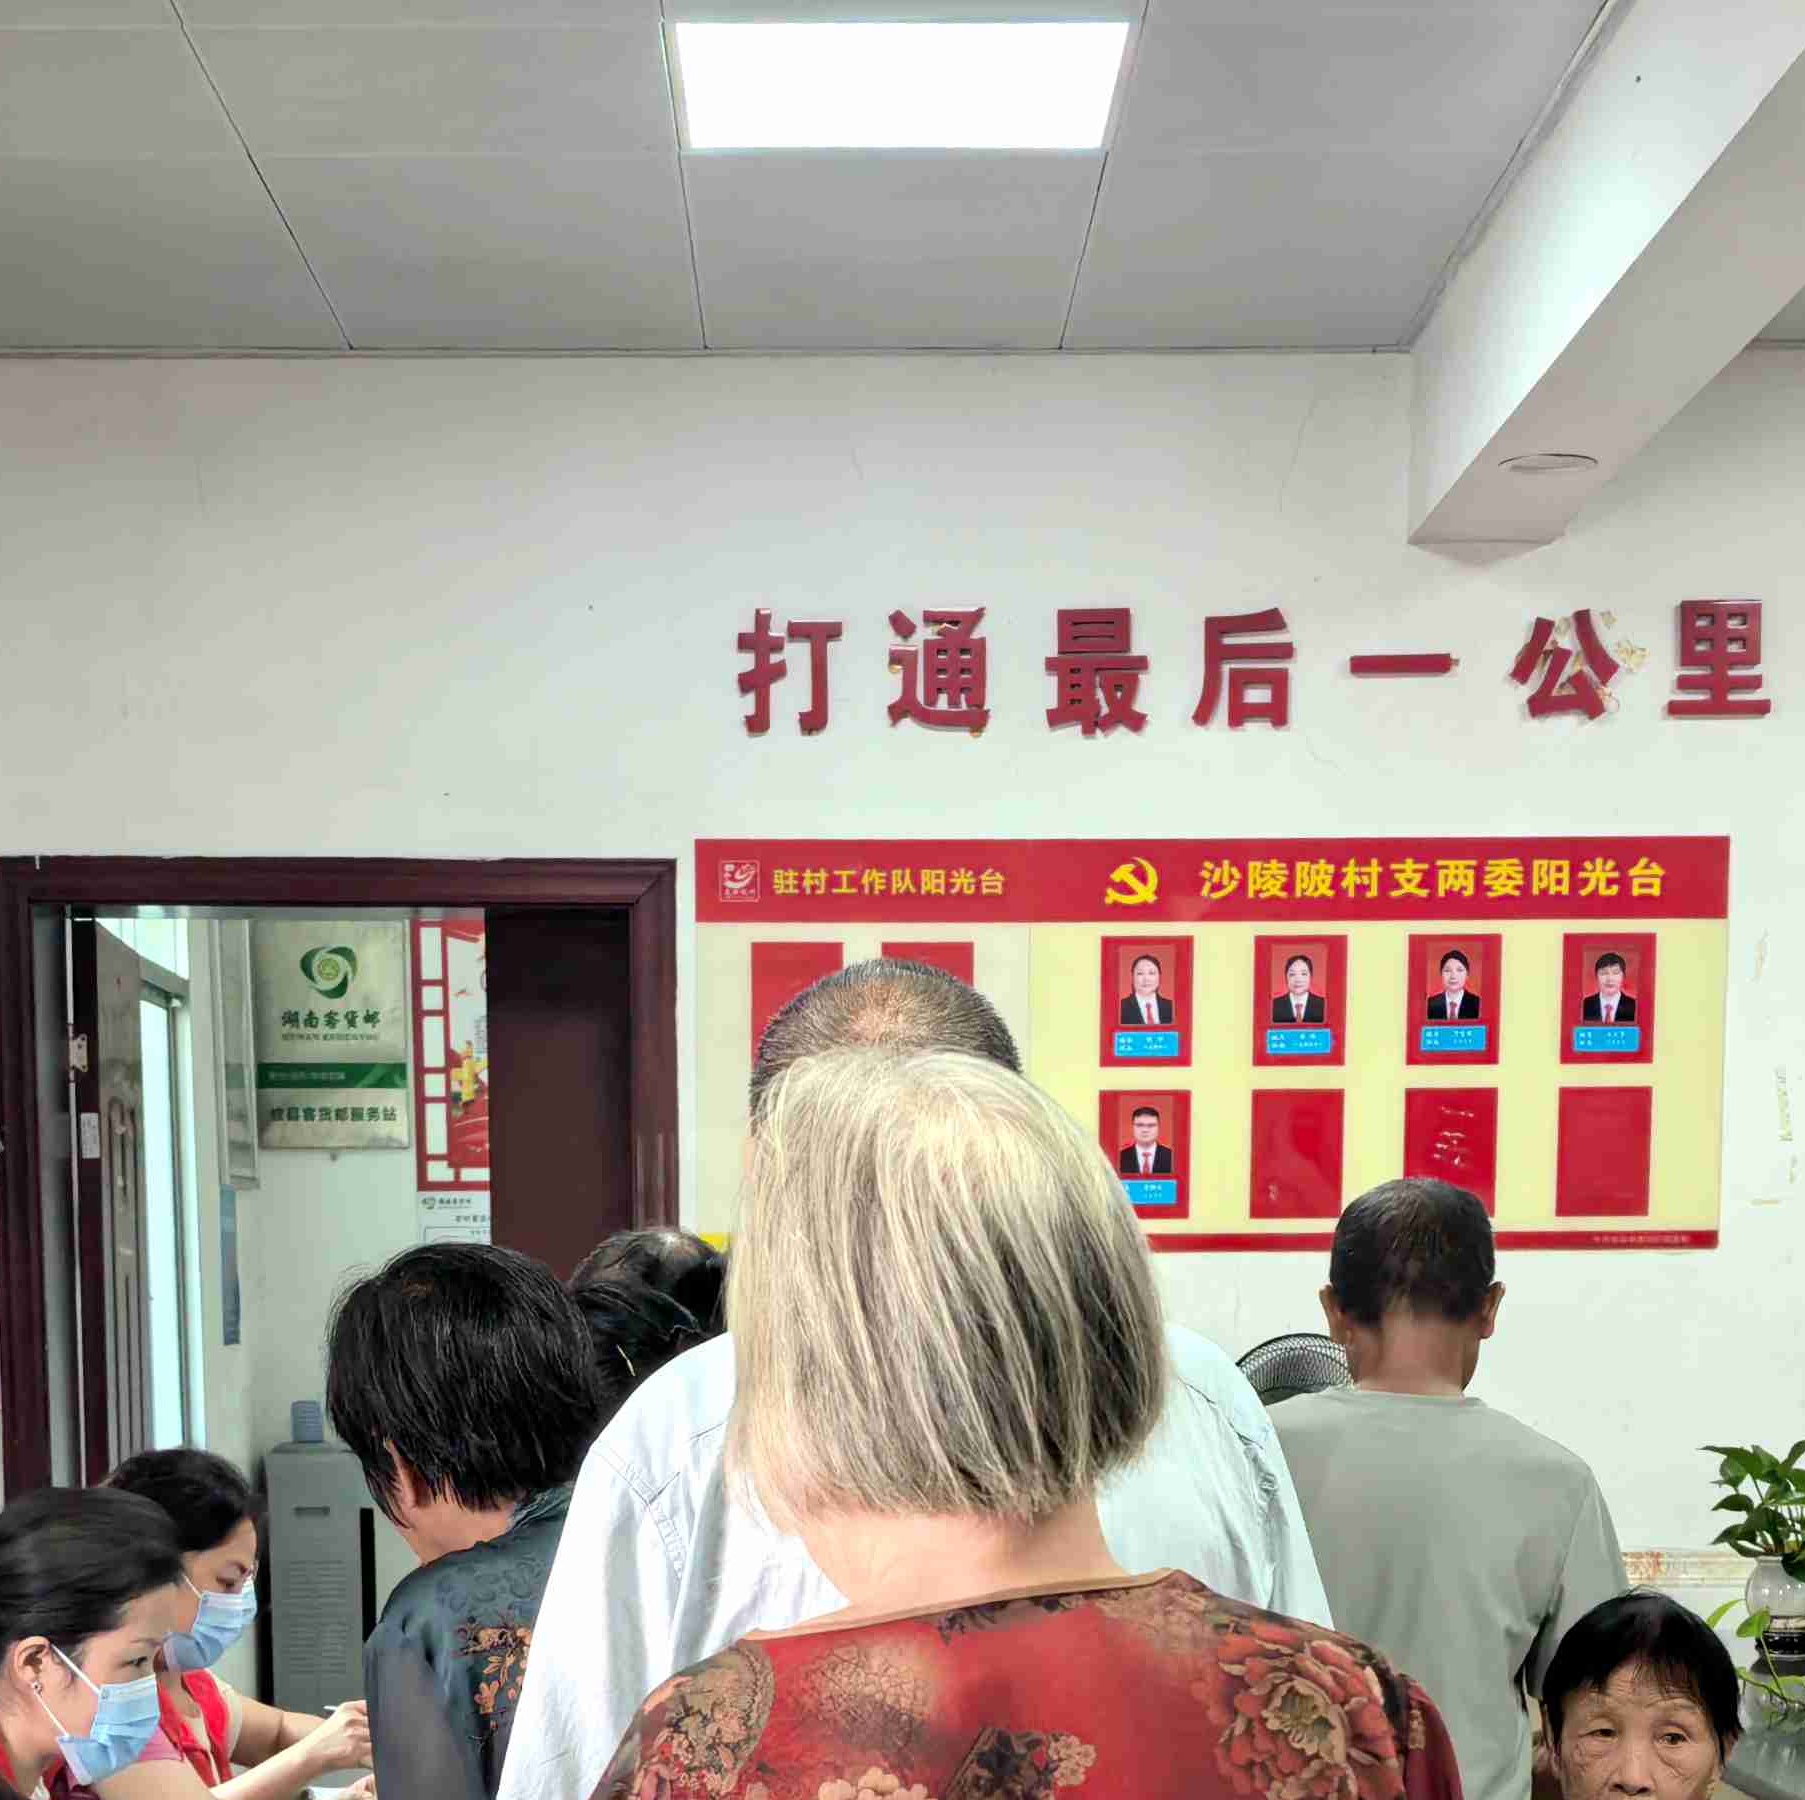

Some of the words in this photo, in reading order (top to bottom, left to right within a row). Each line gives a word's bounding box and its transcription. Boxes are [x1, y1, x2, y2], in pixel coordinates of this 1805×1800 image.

[736, 600, 1771, 737] 打通最后一公里
[772, 868, 1005, 895] 驻村工作队阳光台
[1199, 856, 1667, 902] 沙陵陂村支两委阳光台
[281, 1009, 381, 1029] 湖南客货邮
